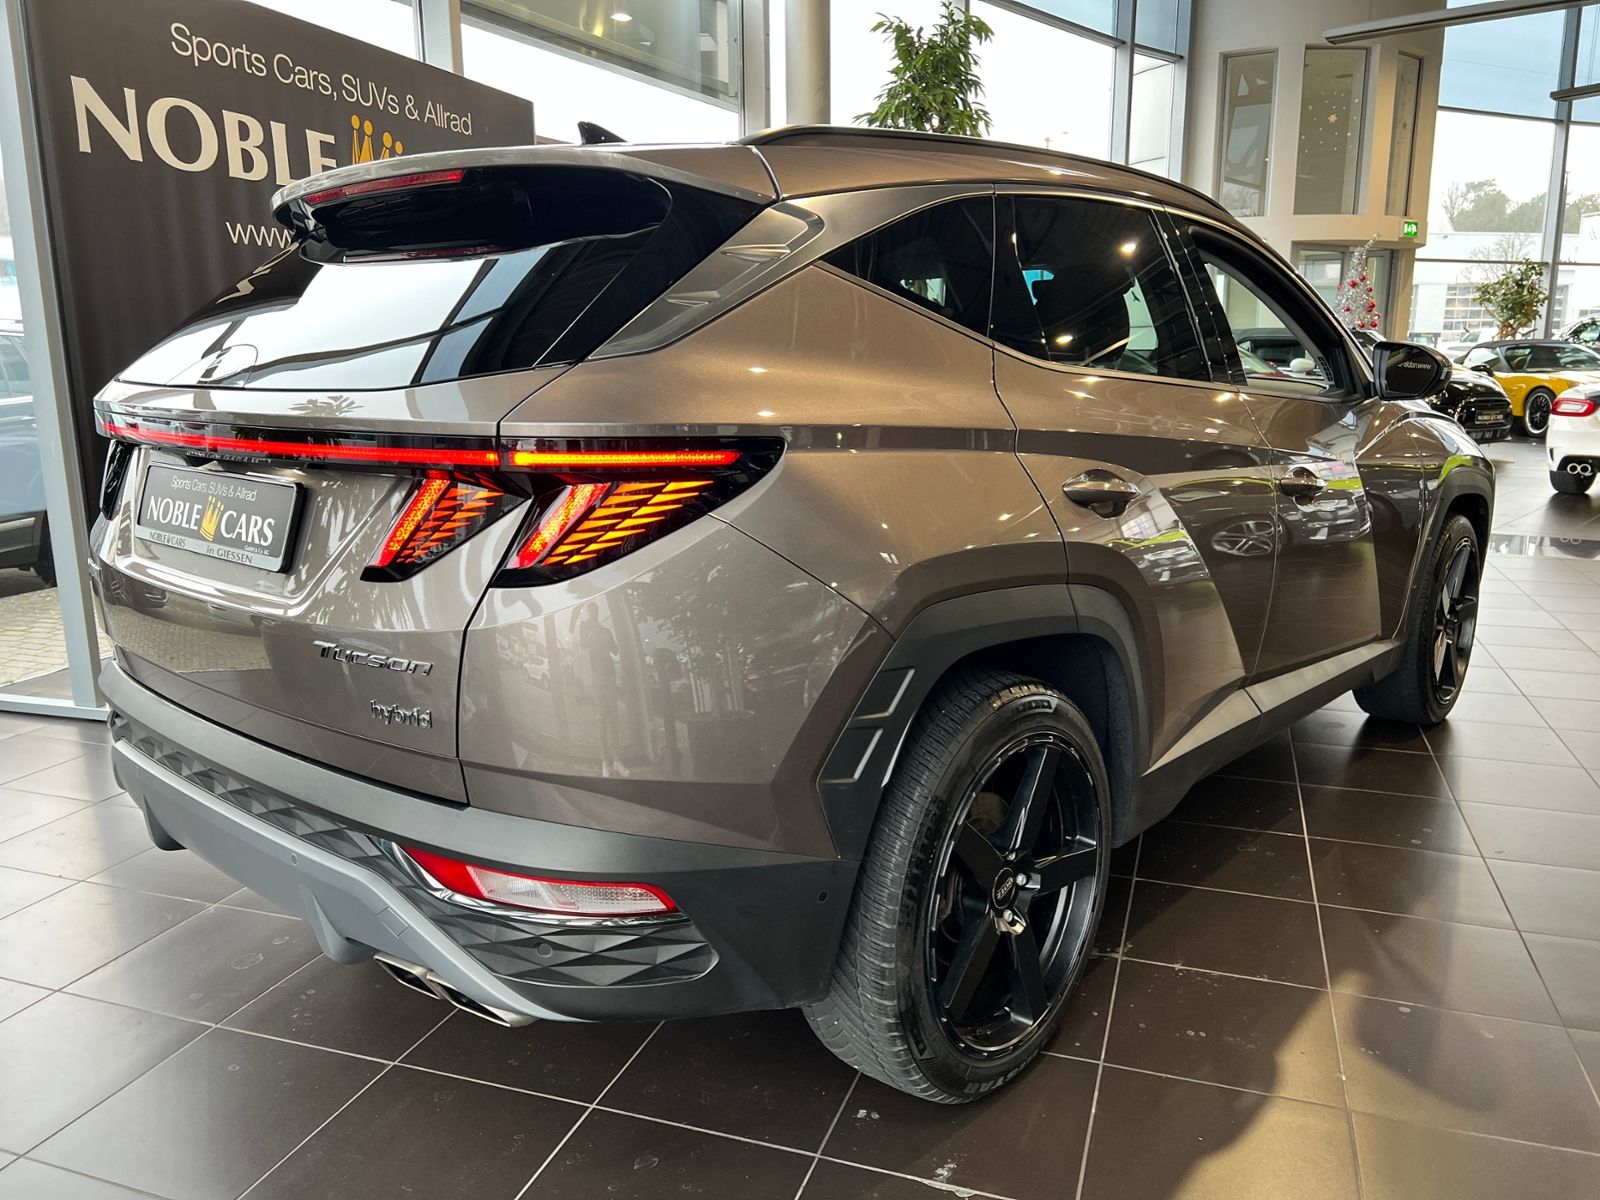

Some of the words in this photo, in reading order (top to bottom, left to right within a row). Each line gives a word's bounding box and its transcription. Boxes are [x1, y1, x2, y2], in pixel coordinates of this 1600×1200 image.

[170, 22, 267, 77] Sports
[273, 53, 338, 101] Cars,
[341, 73, 400, 115] SUVs
[405, 94, 421, 122] &
[424, 100, 473, 136] Allrad
[70, 75, 338, 187] NOBLE
[171, 475, 191, 490] Sports
[228, 485, 234, 497] &
[234, 486, 258, 502] Allrad
[147, 495, 203, 530] NOBLE
[220, 510, 275, 546] CARS
[149, 531, 168, 544] NOBLE
[170, 534, 186, 548] CARS
[206, 545, 215, 554] in
[216, 548, 253, 564] GIESSEN
[369, 700, 433, 729] hybrid
